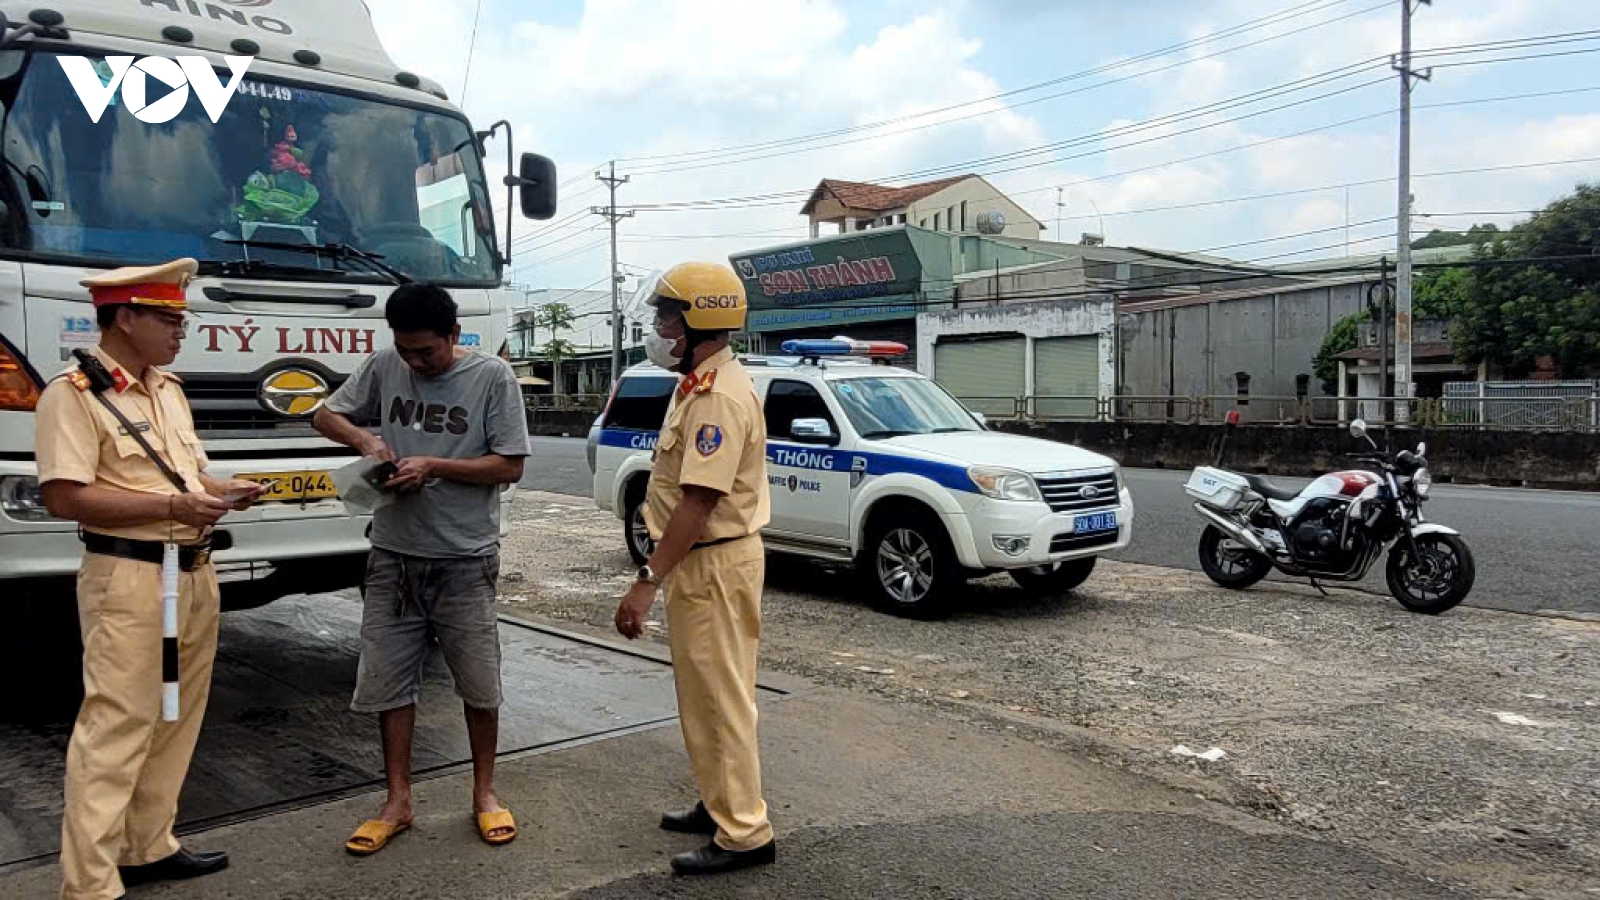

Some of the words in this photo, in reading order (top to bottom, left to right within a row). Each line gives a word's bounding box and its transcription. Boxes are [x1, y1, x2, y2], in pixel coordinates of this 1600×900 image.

[806, 256, 896, 290] THÀNH
[694, 294, 739, 310] CSGT
[275, 327, 376, 354] LINH
[388, 396, 469, 435] NIES
[776, 449, 834, 470] THÔNG
